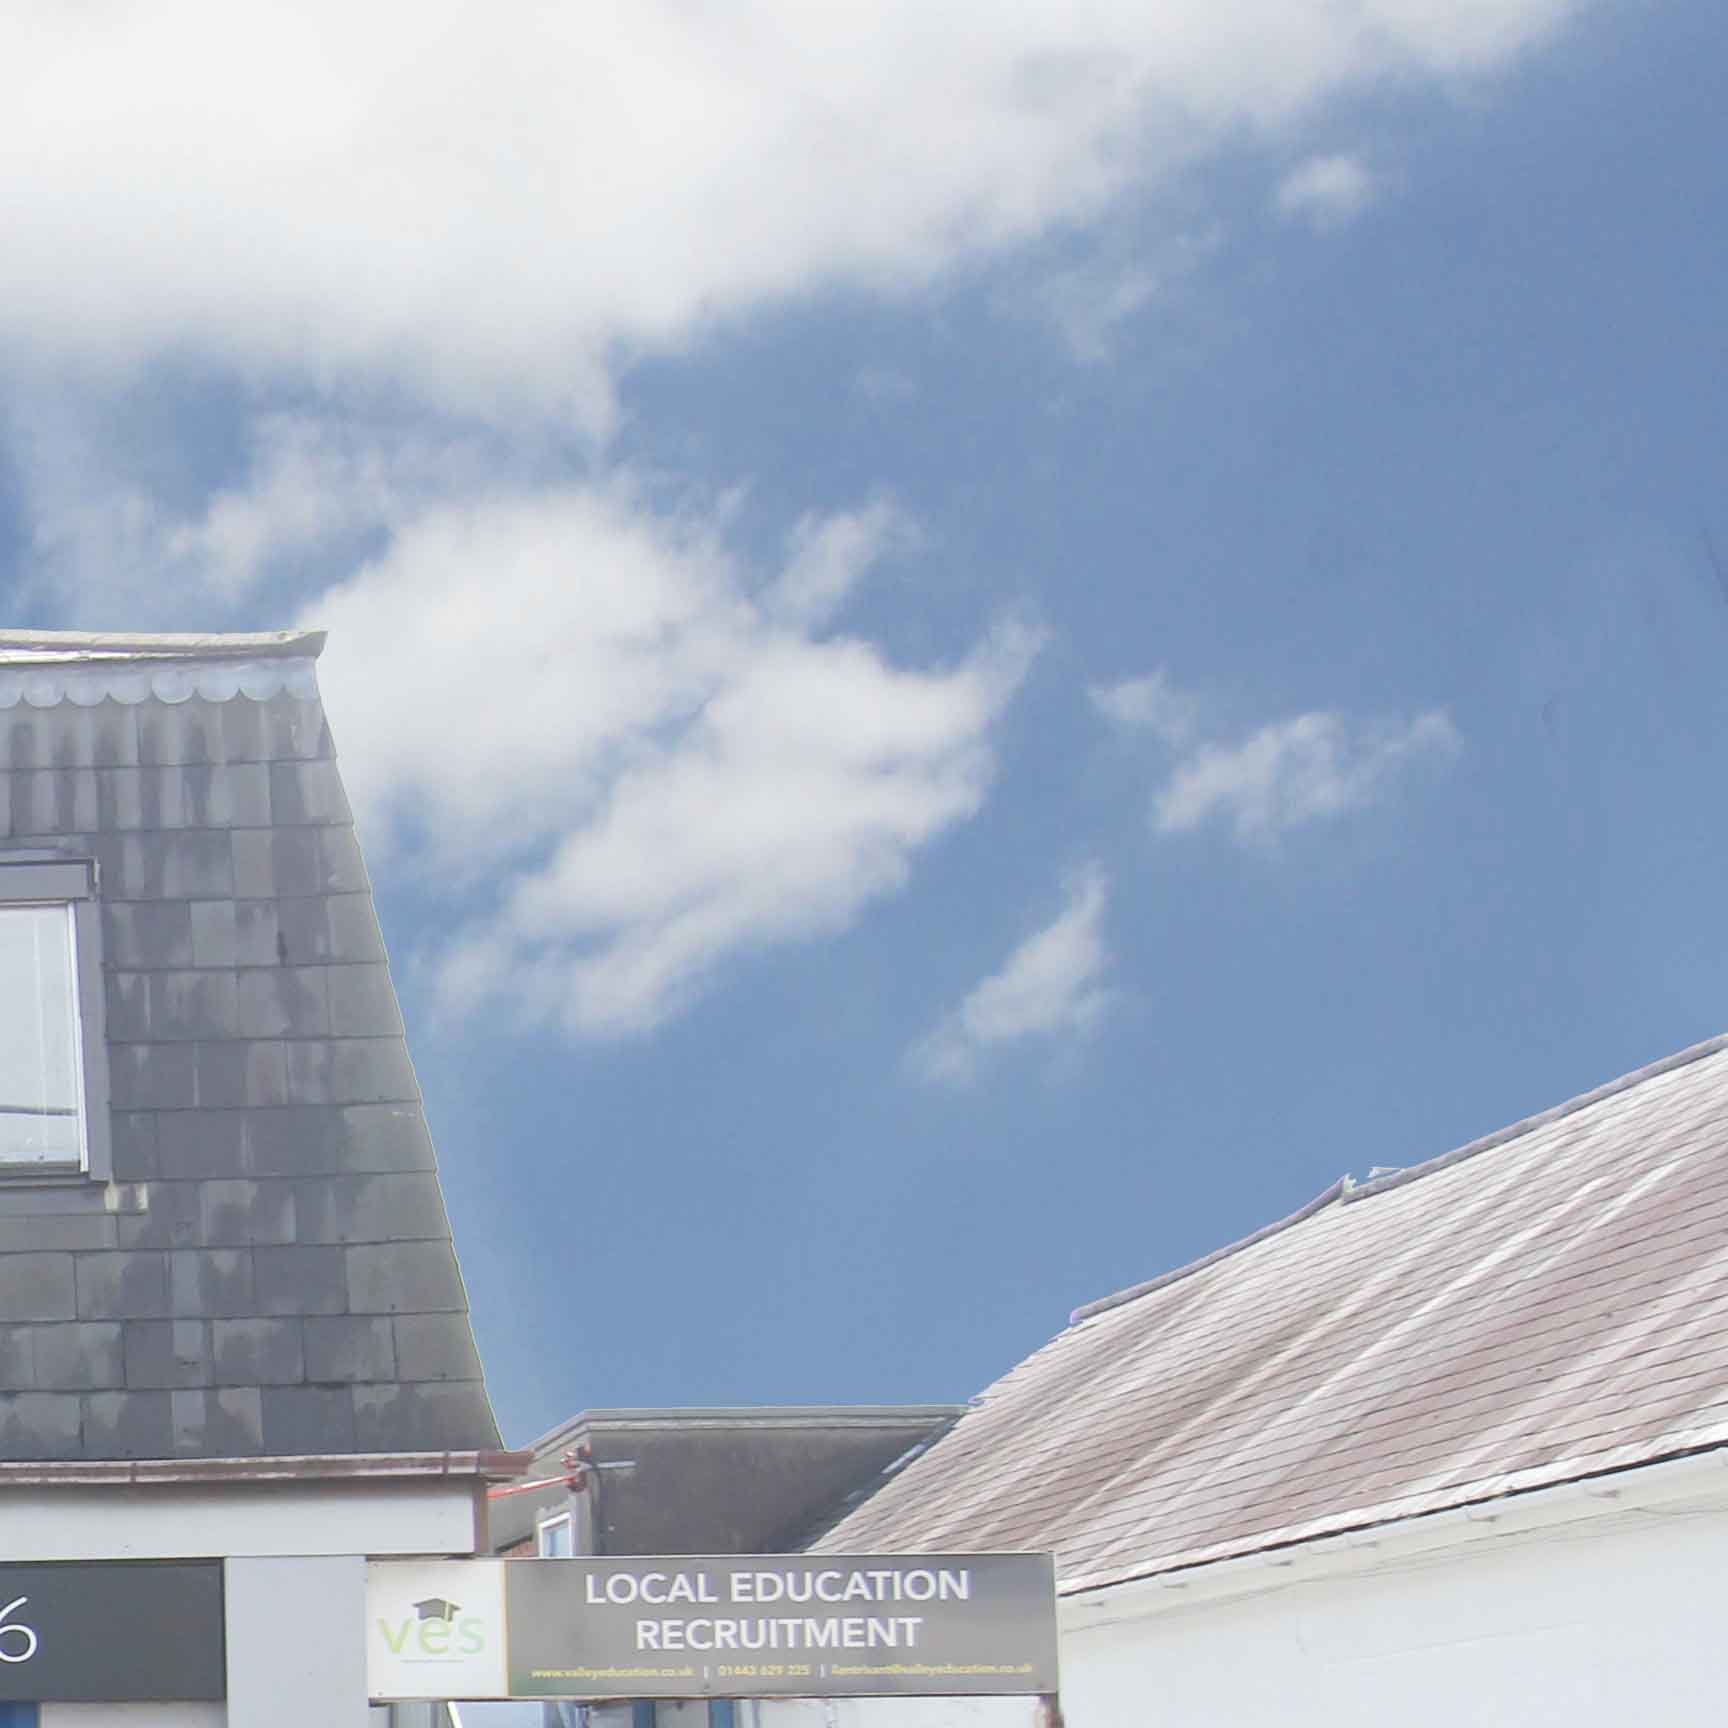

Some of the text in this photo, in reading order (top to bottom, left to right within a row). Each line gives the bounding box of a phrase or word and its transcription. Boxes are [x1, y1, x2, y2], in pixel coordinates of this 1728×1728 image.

[585, 1570, 969, 1604] LOCAL EDUCATION
[376, 1616, 486, 1655] ves
[636, 1617, 923, 1651] RECRUITMENT
